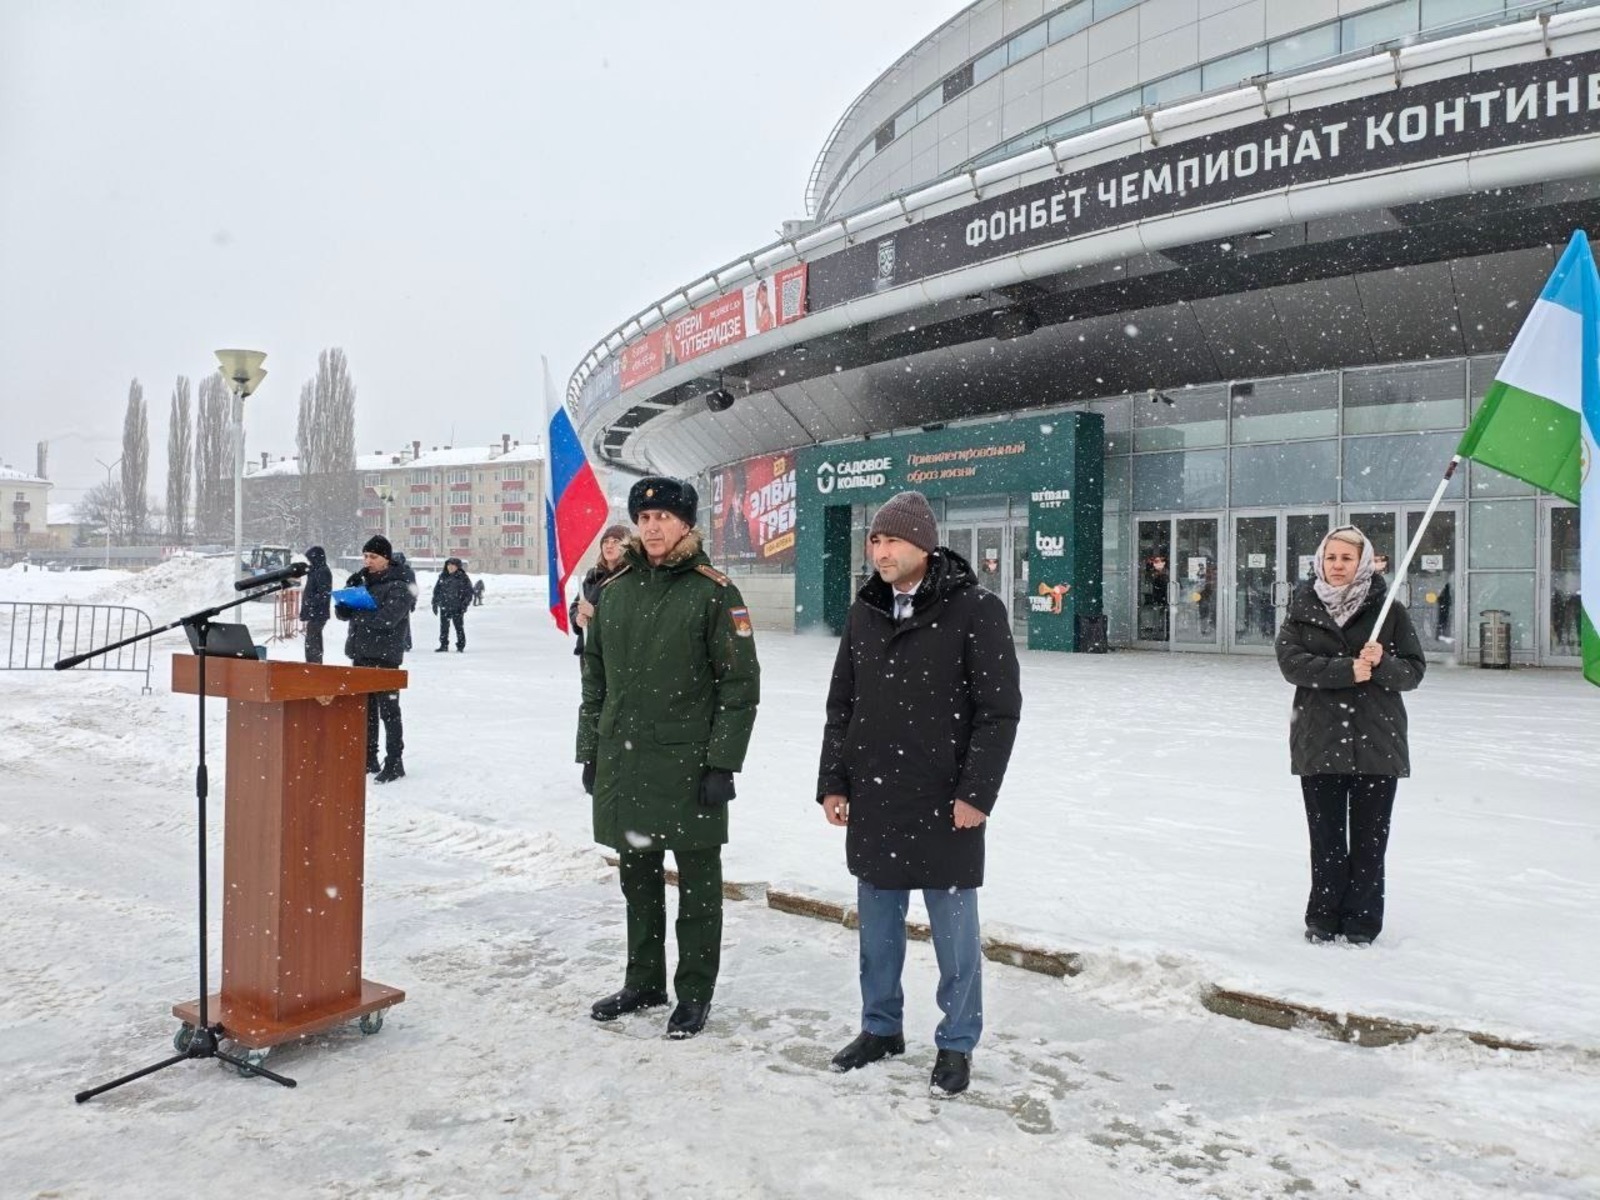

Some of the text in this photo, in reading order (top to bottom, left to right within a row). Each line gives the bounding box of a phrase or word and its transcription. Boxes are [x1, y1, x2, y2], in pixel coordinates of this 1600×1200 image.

[965, 187, 1087, 247] ФОНБЕТ
[1098, 121, 1348, 208] ЧЕМПИОНАТ
[675, 312, 702, 341] ЭТЕРИ
[681, 316, 741, 358] ТУТБЕРИДЗЕ
[906, 441, 1026, 466] Привилегированный
[837, 457, 893, 475] САДОВОЕ
[906, 467, 976, 484] образ жизни
[713, 474, 724, 502] 21
[837, 473, 886, 490] КОЛЬЦО
[1031, 489, 1071, 502] urman
[1040, 501, 1061, 509] CITY
